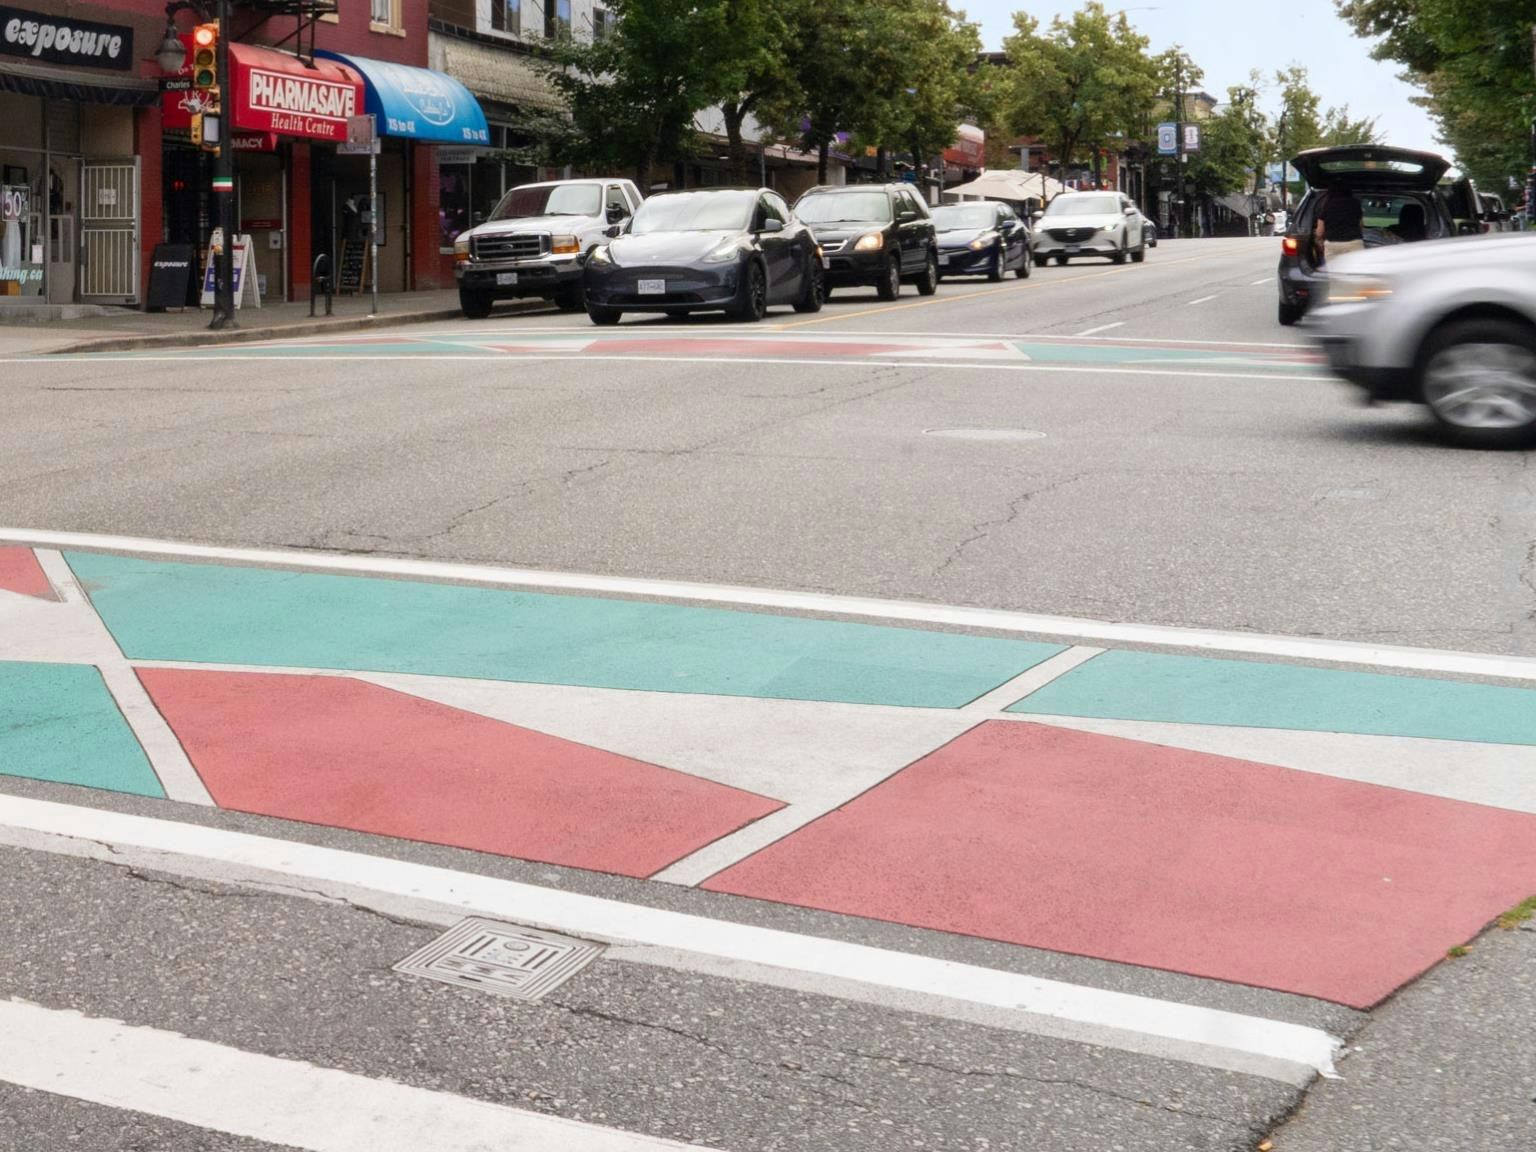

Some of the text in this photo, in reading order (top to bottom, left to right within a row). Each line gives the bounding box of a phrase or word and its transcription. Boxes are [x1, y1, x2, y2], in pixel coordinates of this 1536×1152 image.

[4, 18, 122, 59] exposure
[166, 80, 191, 89] Charles
[252, 73, 354, 117] PHARMASAVE
[271, 113, 335, 135] Health Centre
[231, 138, 264, 148] MACY
[154, 261, 188, 269] exposure
